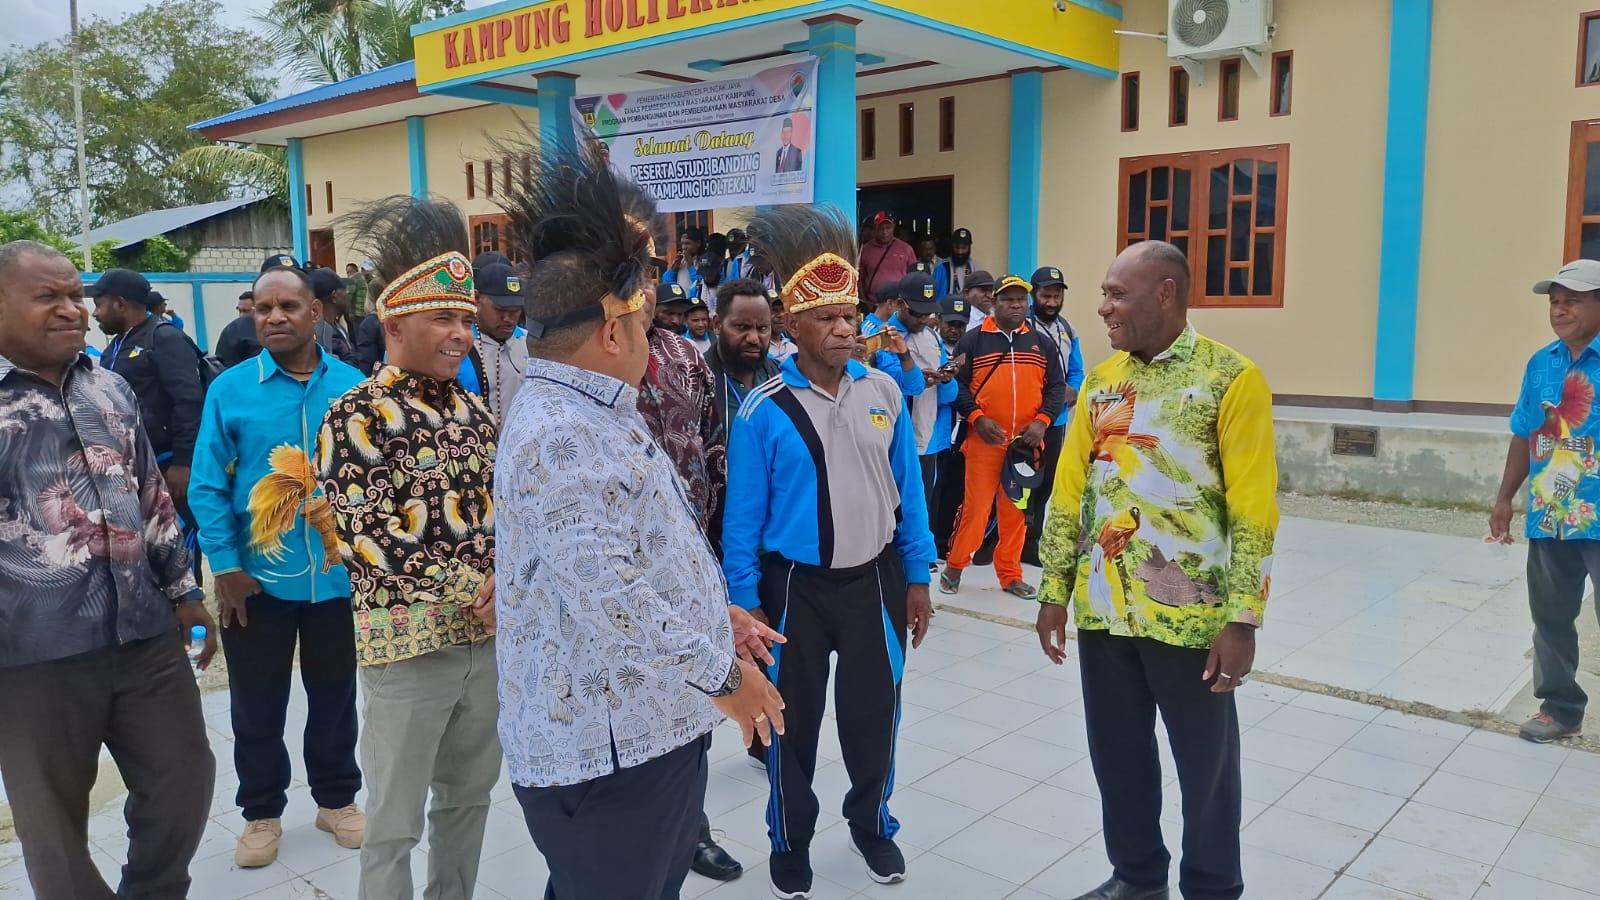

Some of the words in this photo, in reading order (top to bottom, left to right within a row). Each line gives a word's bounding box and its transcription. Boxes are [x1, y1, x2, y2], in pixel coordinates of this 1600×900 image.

[443, 3, 571, 69] KAMPUNG
[584, 0, 750, 38] HOLTE
[624, 106, 640, 115] DINAS
[641, 100, 685, 112] PEMBERDAYAAN
[686, 94, 725, 106] MASYARAKAT
[725, 88, 756, 100] KAMPUNG
[637, 91, 670, 104] PEMERINTAH
[671, 87, 702, 99] KABUPATEN
[703, 84, 726, 95] PUNCAK
[728, 81, 742, 91] JAYA
[627, 110, 668, 122] PEMBANGUNAN
[668, 109, 680, 118] DAN
[681, 103, 727, 116] PEMBERDAYAAN
[728, 96, 768, 110] MASYARAKAT
[769, 93, 786, 104] DESA
[634, 135, 692, 157] Selamat
[694, 130, 755, 151] Datang
[631, 162, 676, 181] PESERTA
[676, 158, 710, 178] STUDI
[710, 152, 760, 176] BANDING
[650, 180, 700, 200] KAMPUNG
[701, 174, 756, 197] HOLTEKAM
[571, 379, 606, 399] PAPUA
[548, 515, 585, 536] PAPUA
[673, 719, 701, 739] PAPUA
[619, 742, 653, 760] PAPUA
[530, 766, 558, 777] PAPUA
